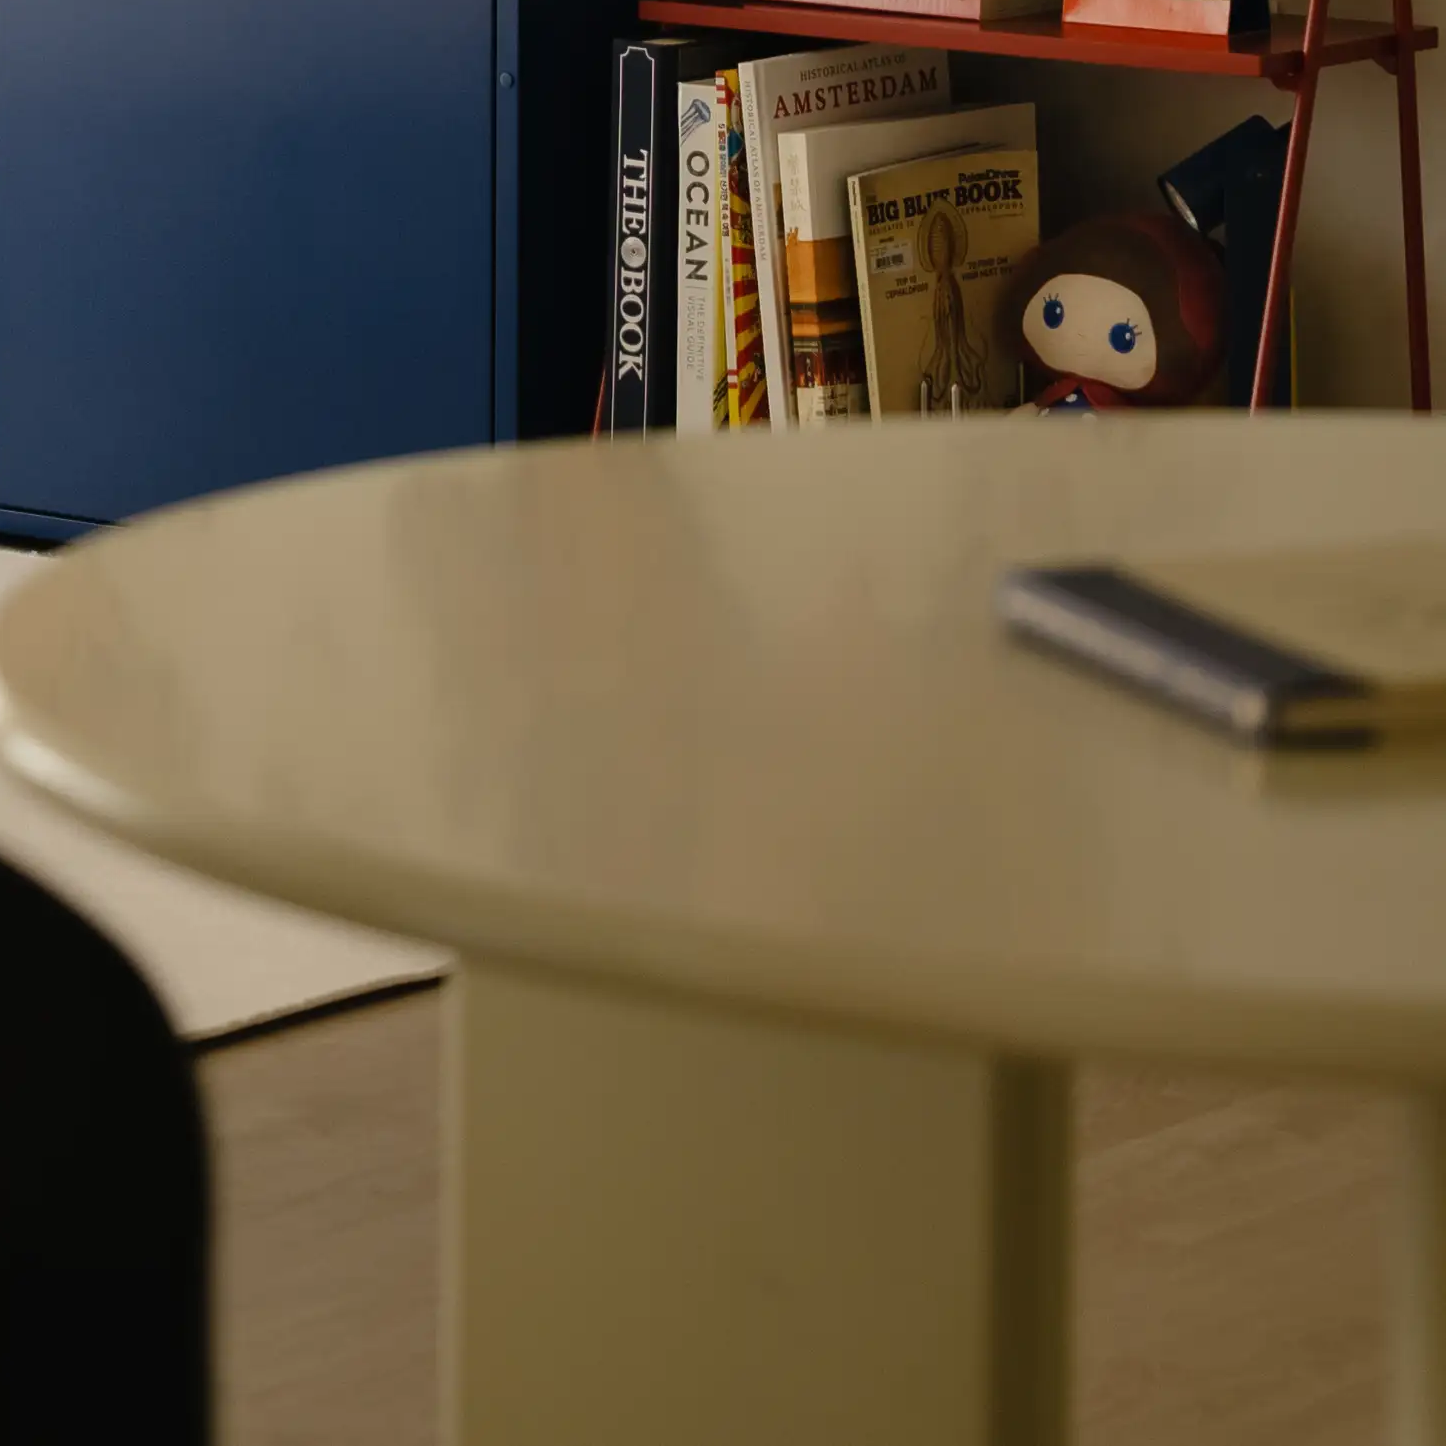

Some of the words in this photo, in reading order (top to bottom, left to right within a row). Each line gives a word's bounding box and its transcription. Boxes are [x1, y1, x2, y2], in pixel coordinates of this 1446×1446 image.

[773, 66, 939, 120] AMSTERDAM
[800, 60, 858, 82] HISTORICAL
[622, 149, 649, 235] THE
[866, 200, 900, 226] BIG
[954, 179, 1023, 207] BOOK
[685, 150, 710, 282] OCEAN
[618, 267, 645, 380] BOOK
[686, 295, 695, 330] VISUAL
[697, 296, 706, 318] THE
[686, 332, 695, 371] GUIDE
